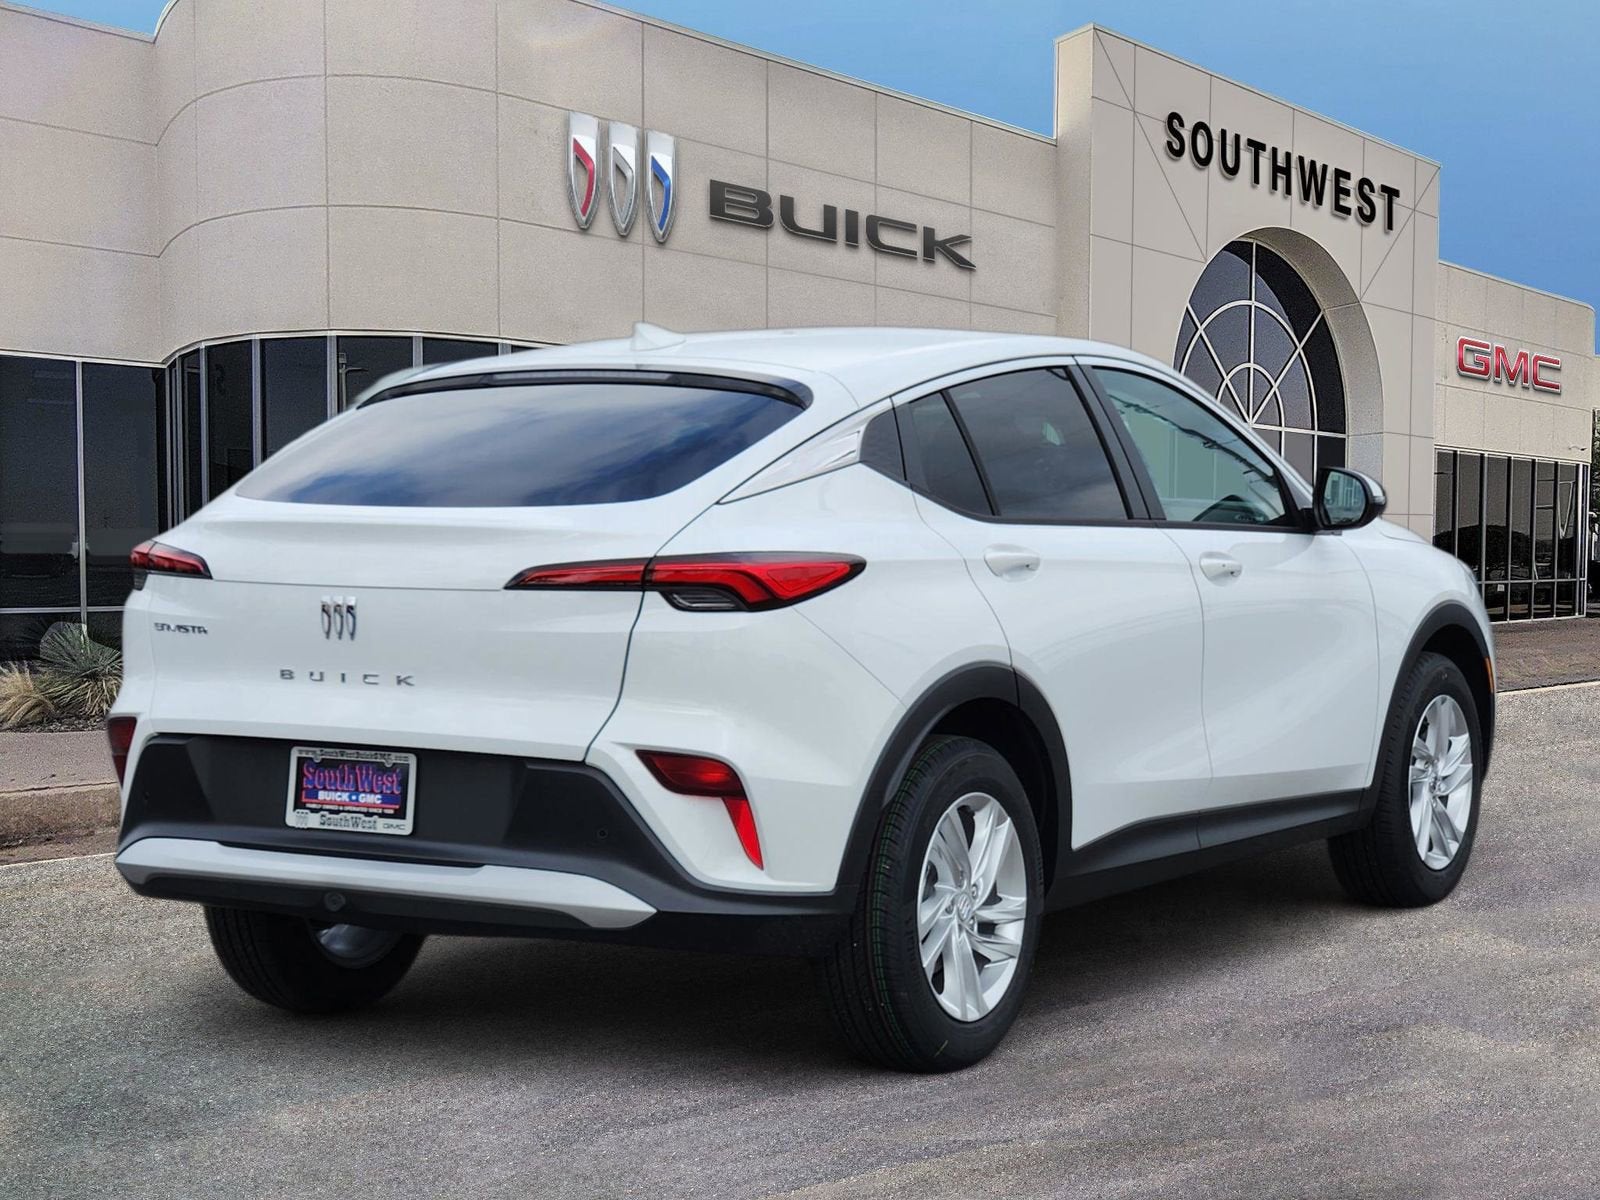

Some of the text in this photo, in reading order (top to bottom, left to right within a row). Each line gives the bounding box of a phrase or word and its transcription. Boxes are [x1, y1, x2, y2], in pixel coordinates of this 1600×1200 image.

[1165, 111, 1401, 233] SOUTHWEST
[709, 178, 977, 271] BUICK
[1457, 336, 1562, 394] GMC
[279, 668, 416, 687] BUICK
[317, 790, 382, 804] BUICK GMC
[382, 822, 406, 830] GMC
